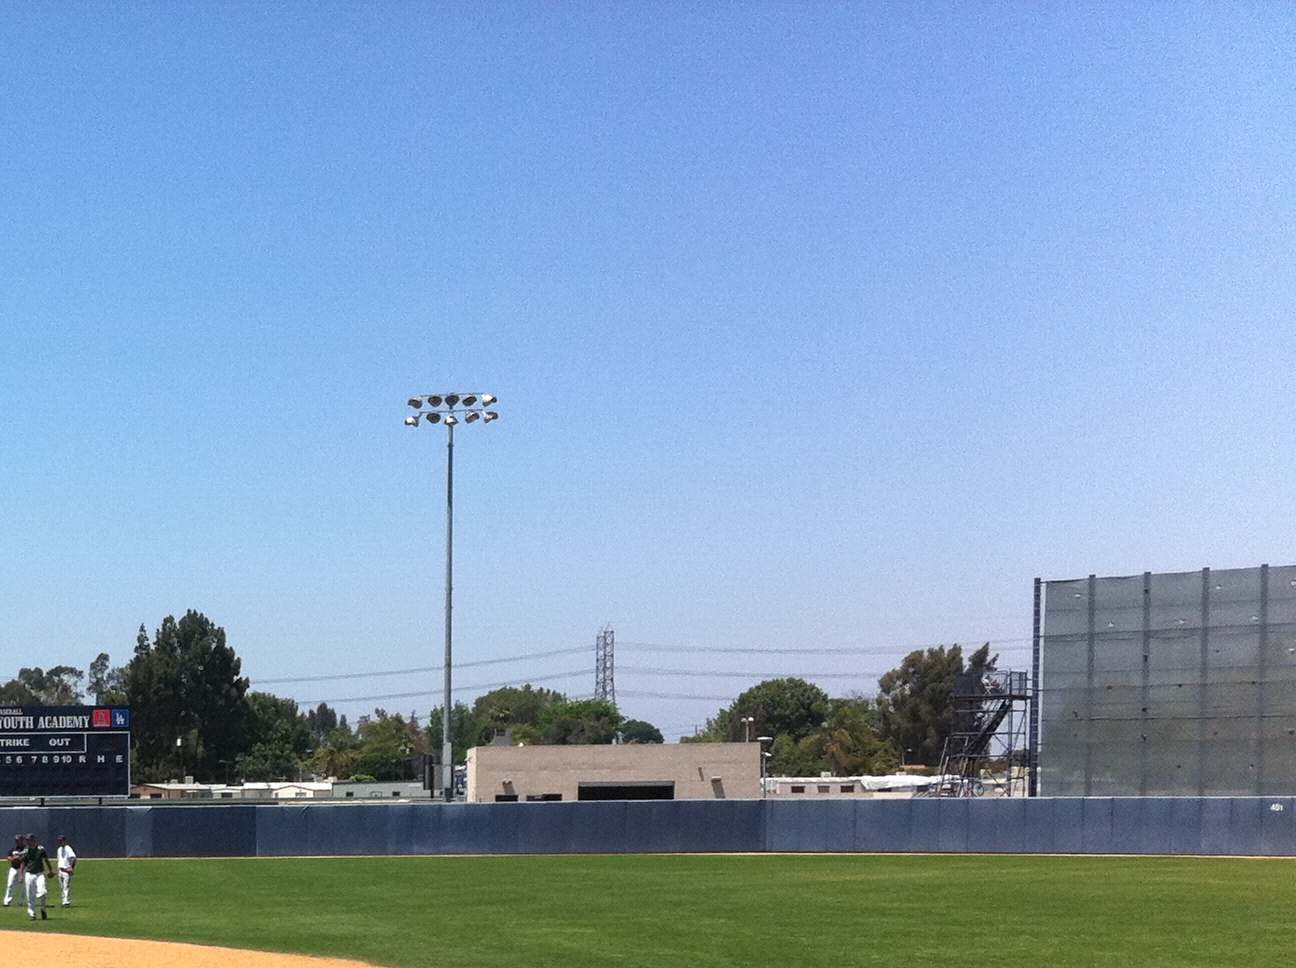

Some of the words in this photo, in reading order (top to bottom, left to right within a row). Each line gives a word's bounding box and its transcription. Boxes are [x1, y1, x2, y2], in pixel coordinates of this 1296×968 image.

[38, 715, 90, 729] ACADEMY
[49, 738, 71, 746] OUT
[6, 756, 12, 764] 5
[16, 756, 23, 764] 6
[31, 756, 37, 764] 7
[42, 756, 48, 764] 8
[53, 755, 60, 764] 9
[62, 755, 72, 764] 10
[78, 755, 86, 763] R
[97, 755, 105, 763] H
[116, 755, 123, 763] E
